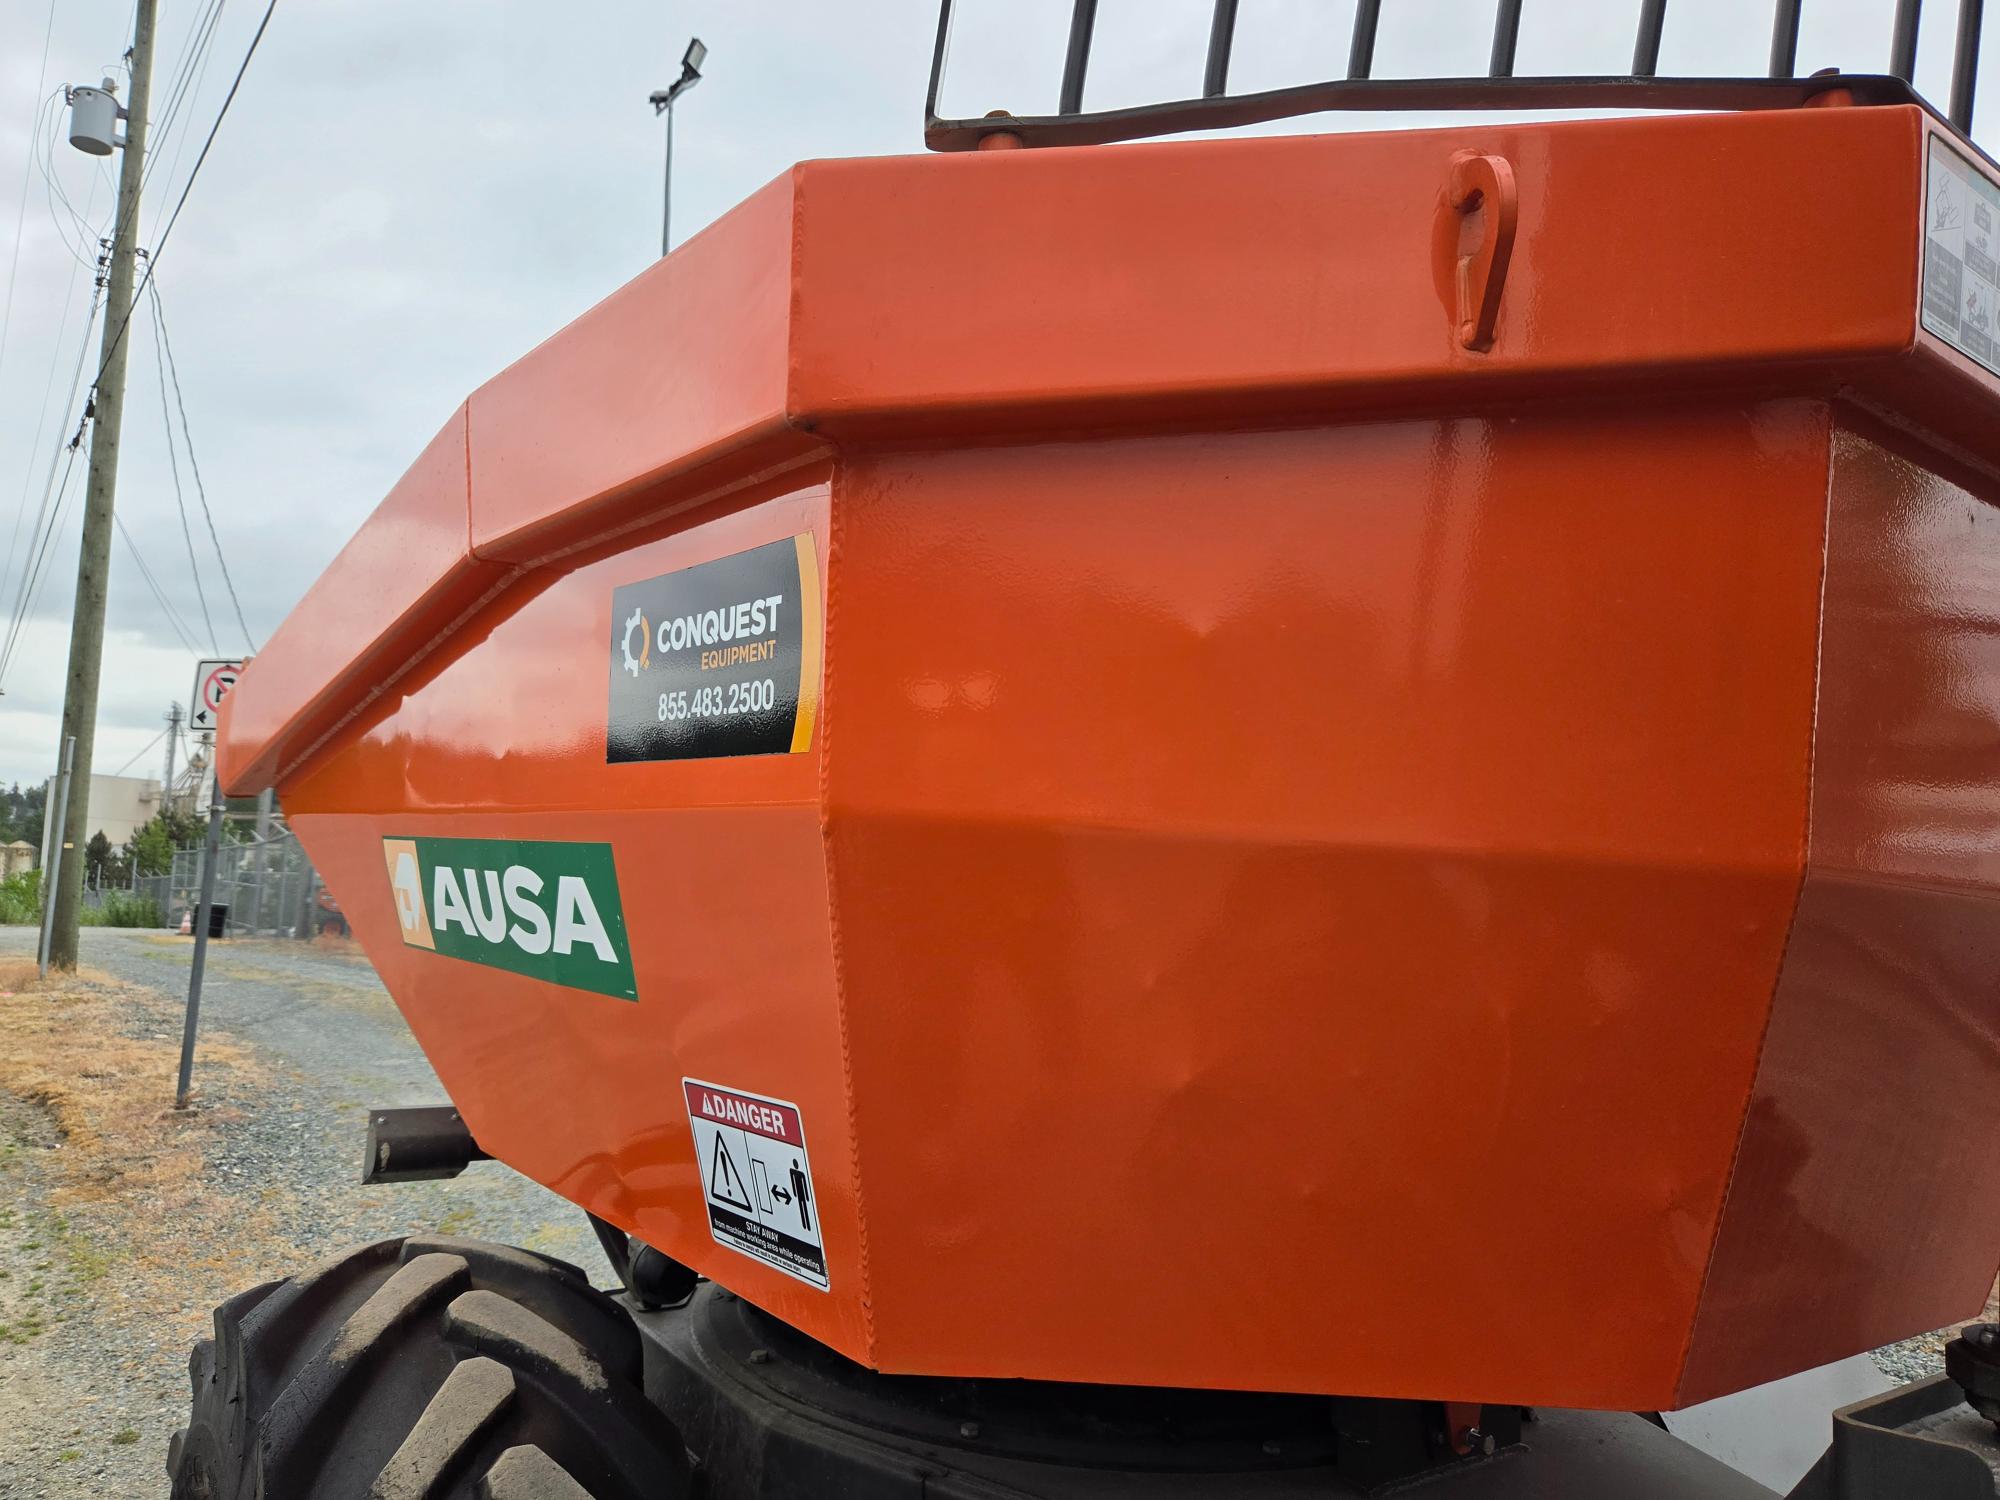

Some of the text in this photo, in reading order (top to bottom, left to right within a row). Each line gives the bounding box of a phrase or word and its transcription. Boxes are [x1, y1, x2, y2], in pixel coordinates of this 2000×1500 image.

[657, 595, 783, 653] CONQUEST
[701, 640, 776, 671] EQUIPMENT
[658, 679, 775, 721] 855.483.2500
[434, 865, 619, 964] AUSA
[713, 1095, 786, 1137] DANGER
[725, 1224, 746, 1239] machine
[746, 1233, 767, 1249] working
[767, 1241, 779, 1252] area
[779, 1247, 793, 1259] while
[794, 1253, 820, 1273] operating
[745, 1221, 779, 1242] STAY AWAY
